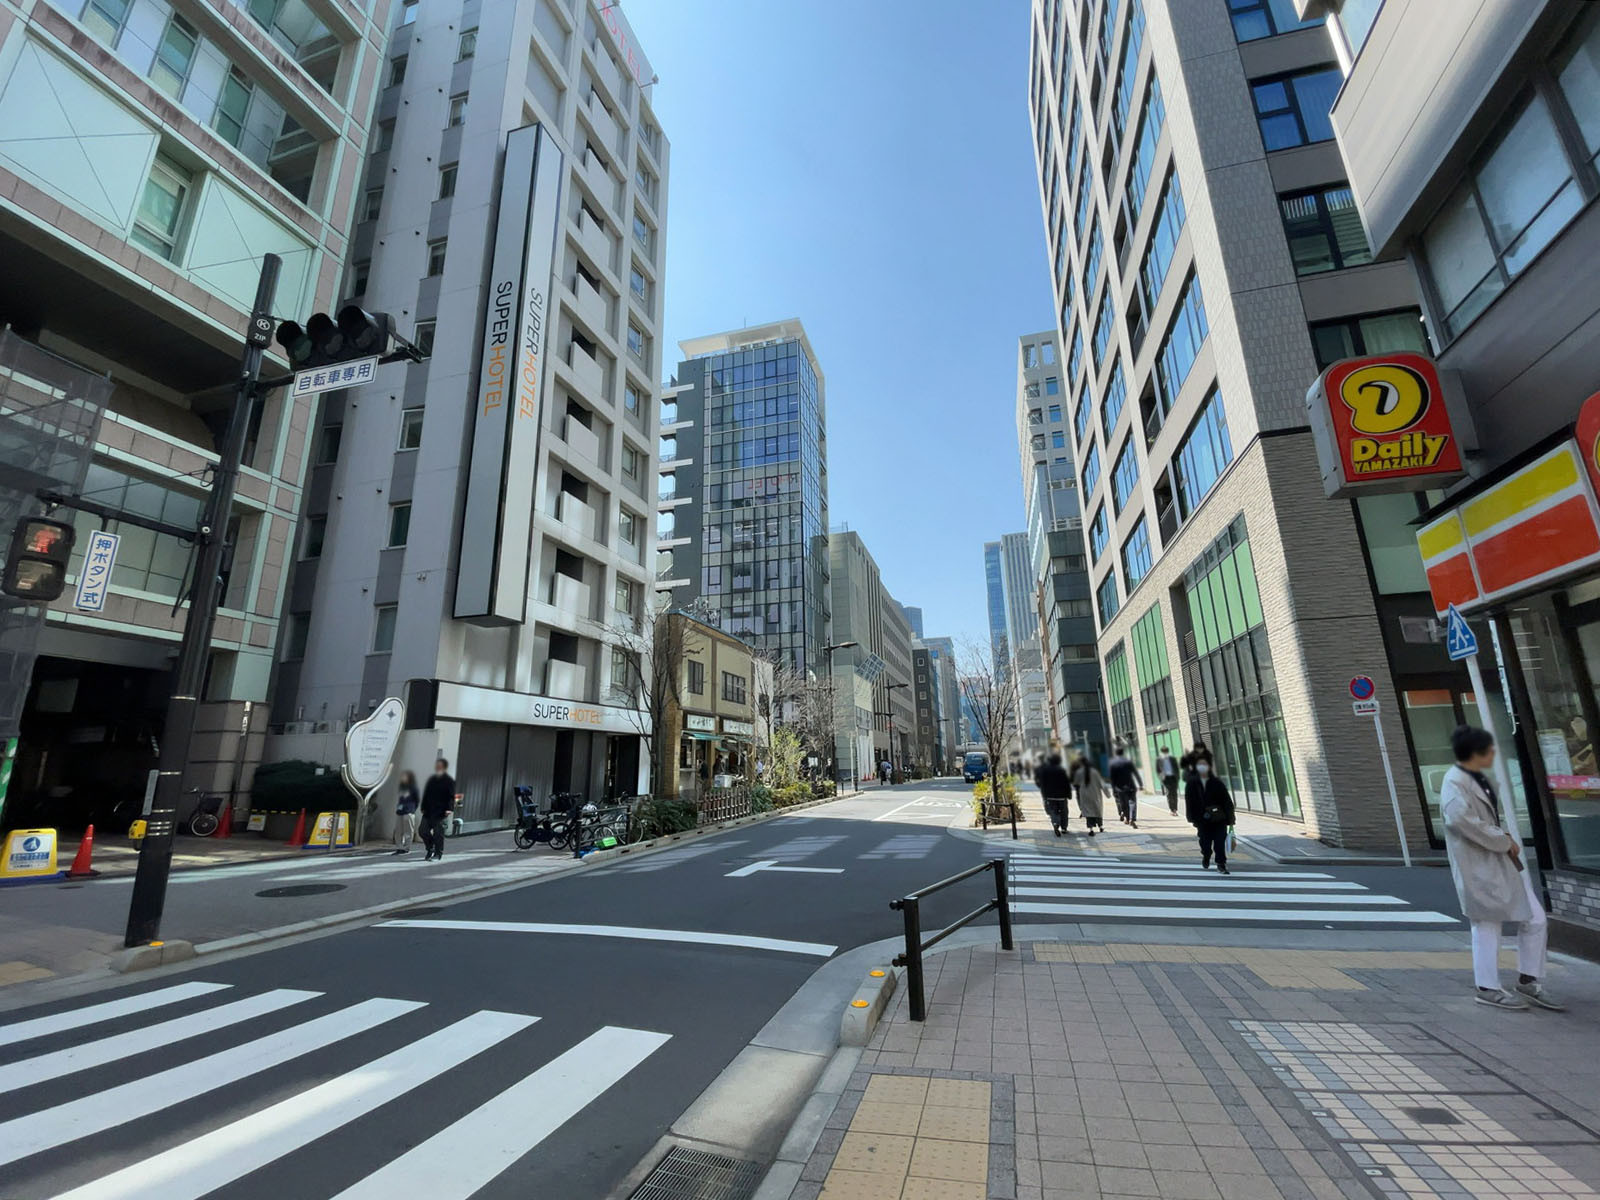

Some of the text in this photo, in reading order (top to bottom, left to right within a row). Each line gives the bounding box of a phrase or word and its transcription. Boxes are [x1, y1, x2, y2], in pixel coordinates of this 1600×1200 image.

[300, 363, 371, 391] 自転車専用
[1351, 432, 1448, 467] Daily
[1355, 455, 1424, 473] YAMAZAKI
[82, 537, 112, 605] 押ボタン式
